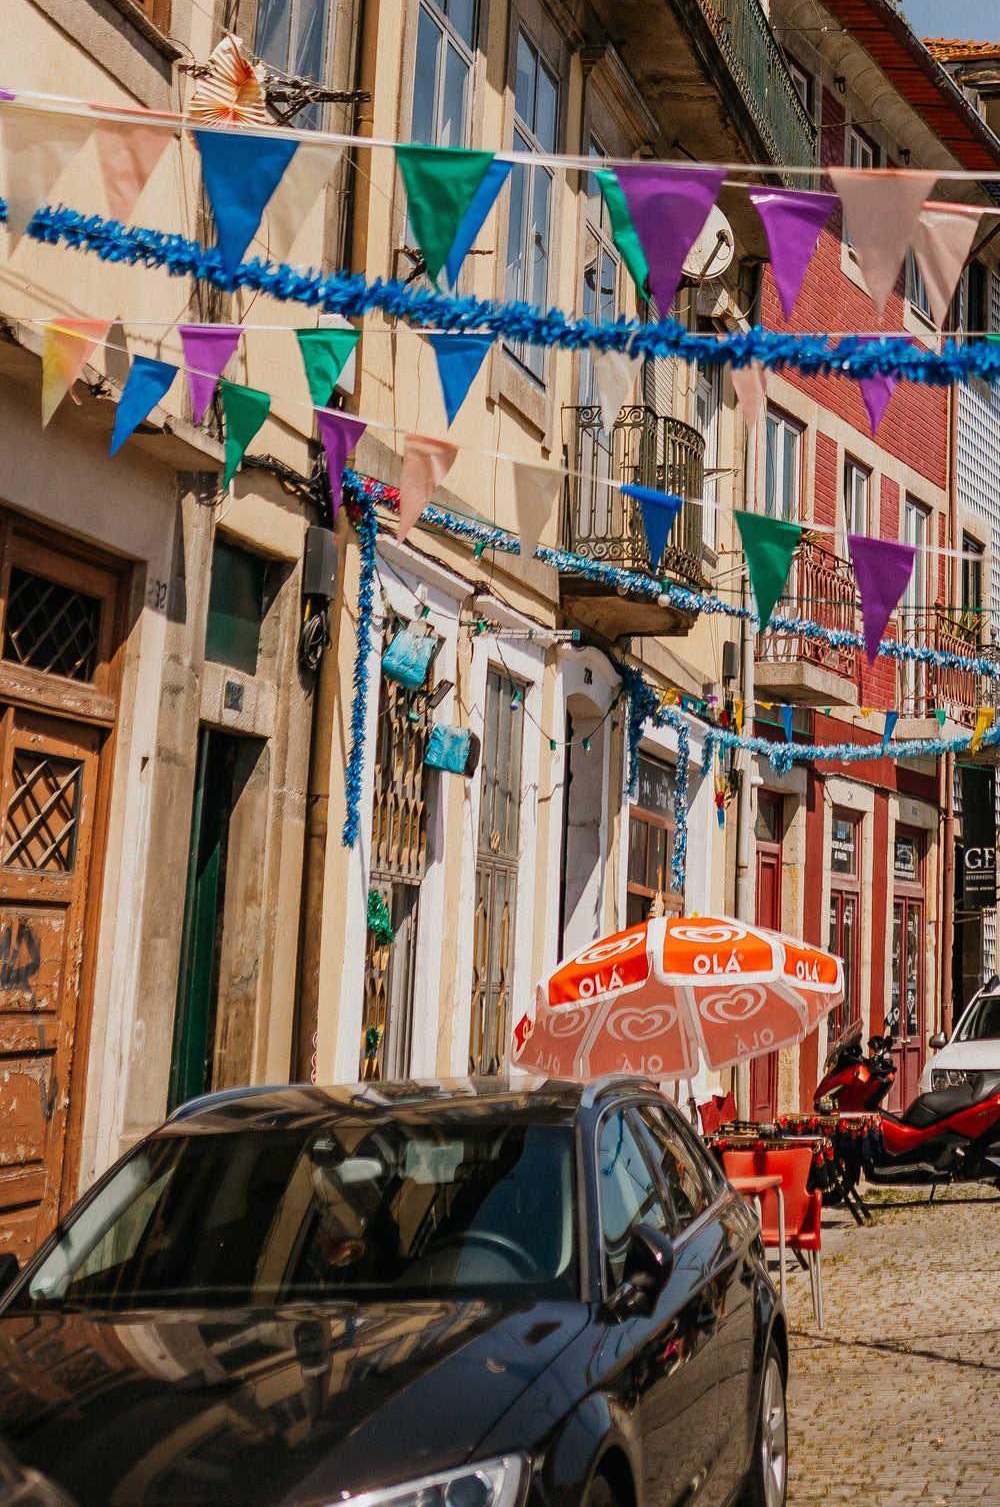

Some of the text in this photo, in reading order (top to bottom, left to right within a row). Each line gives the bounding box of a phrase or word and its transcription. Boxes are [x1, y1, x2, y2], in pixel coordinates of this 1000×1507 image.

[693, 948, 742, 975] OLÁ
[796, 958, 819, 983] OLÁ
[578, 964, 624, 998] OLÁ
